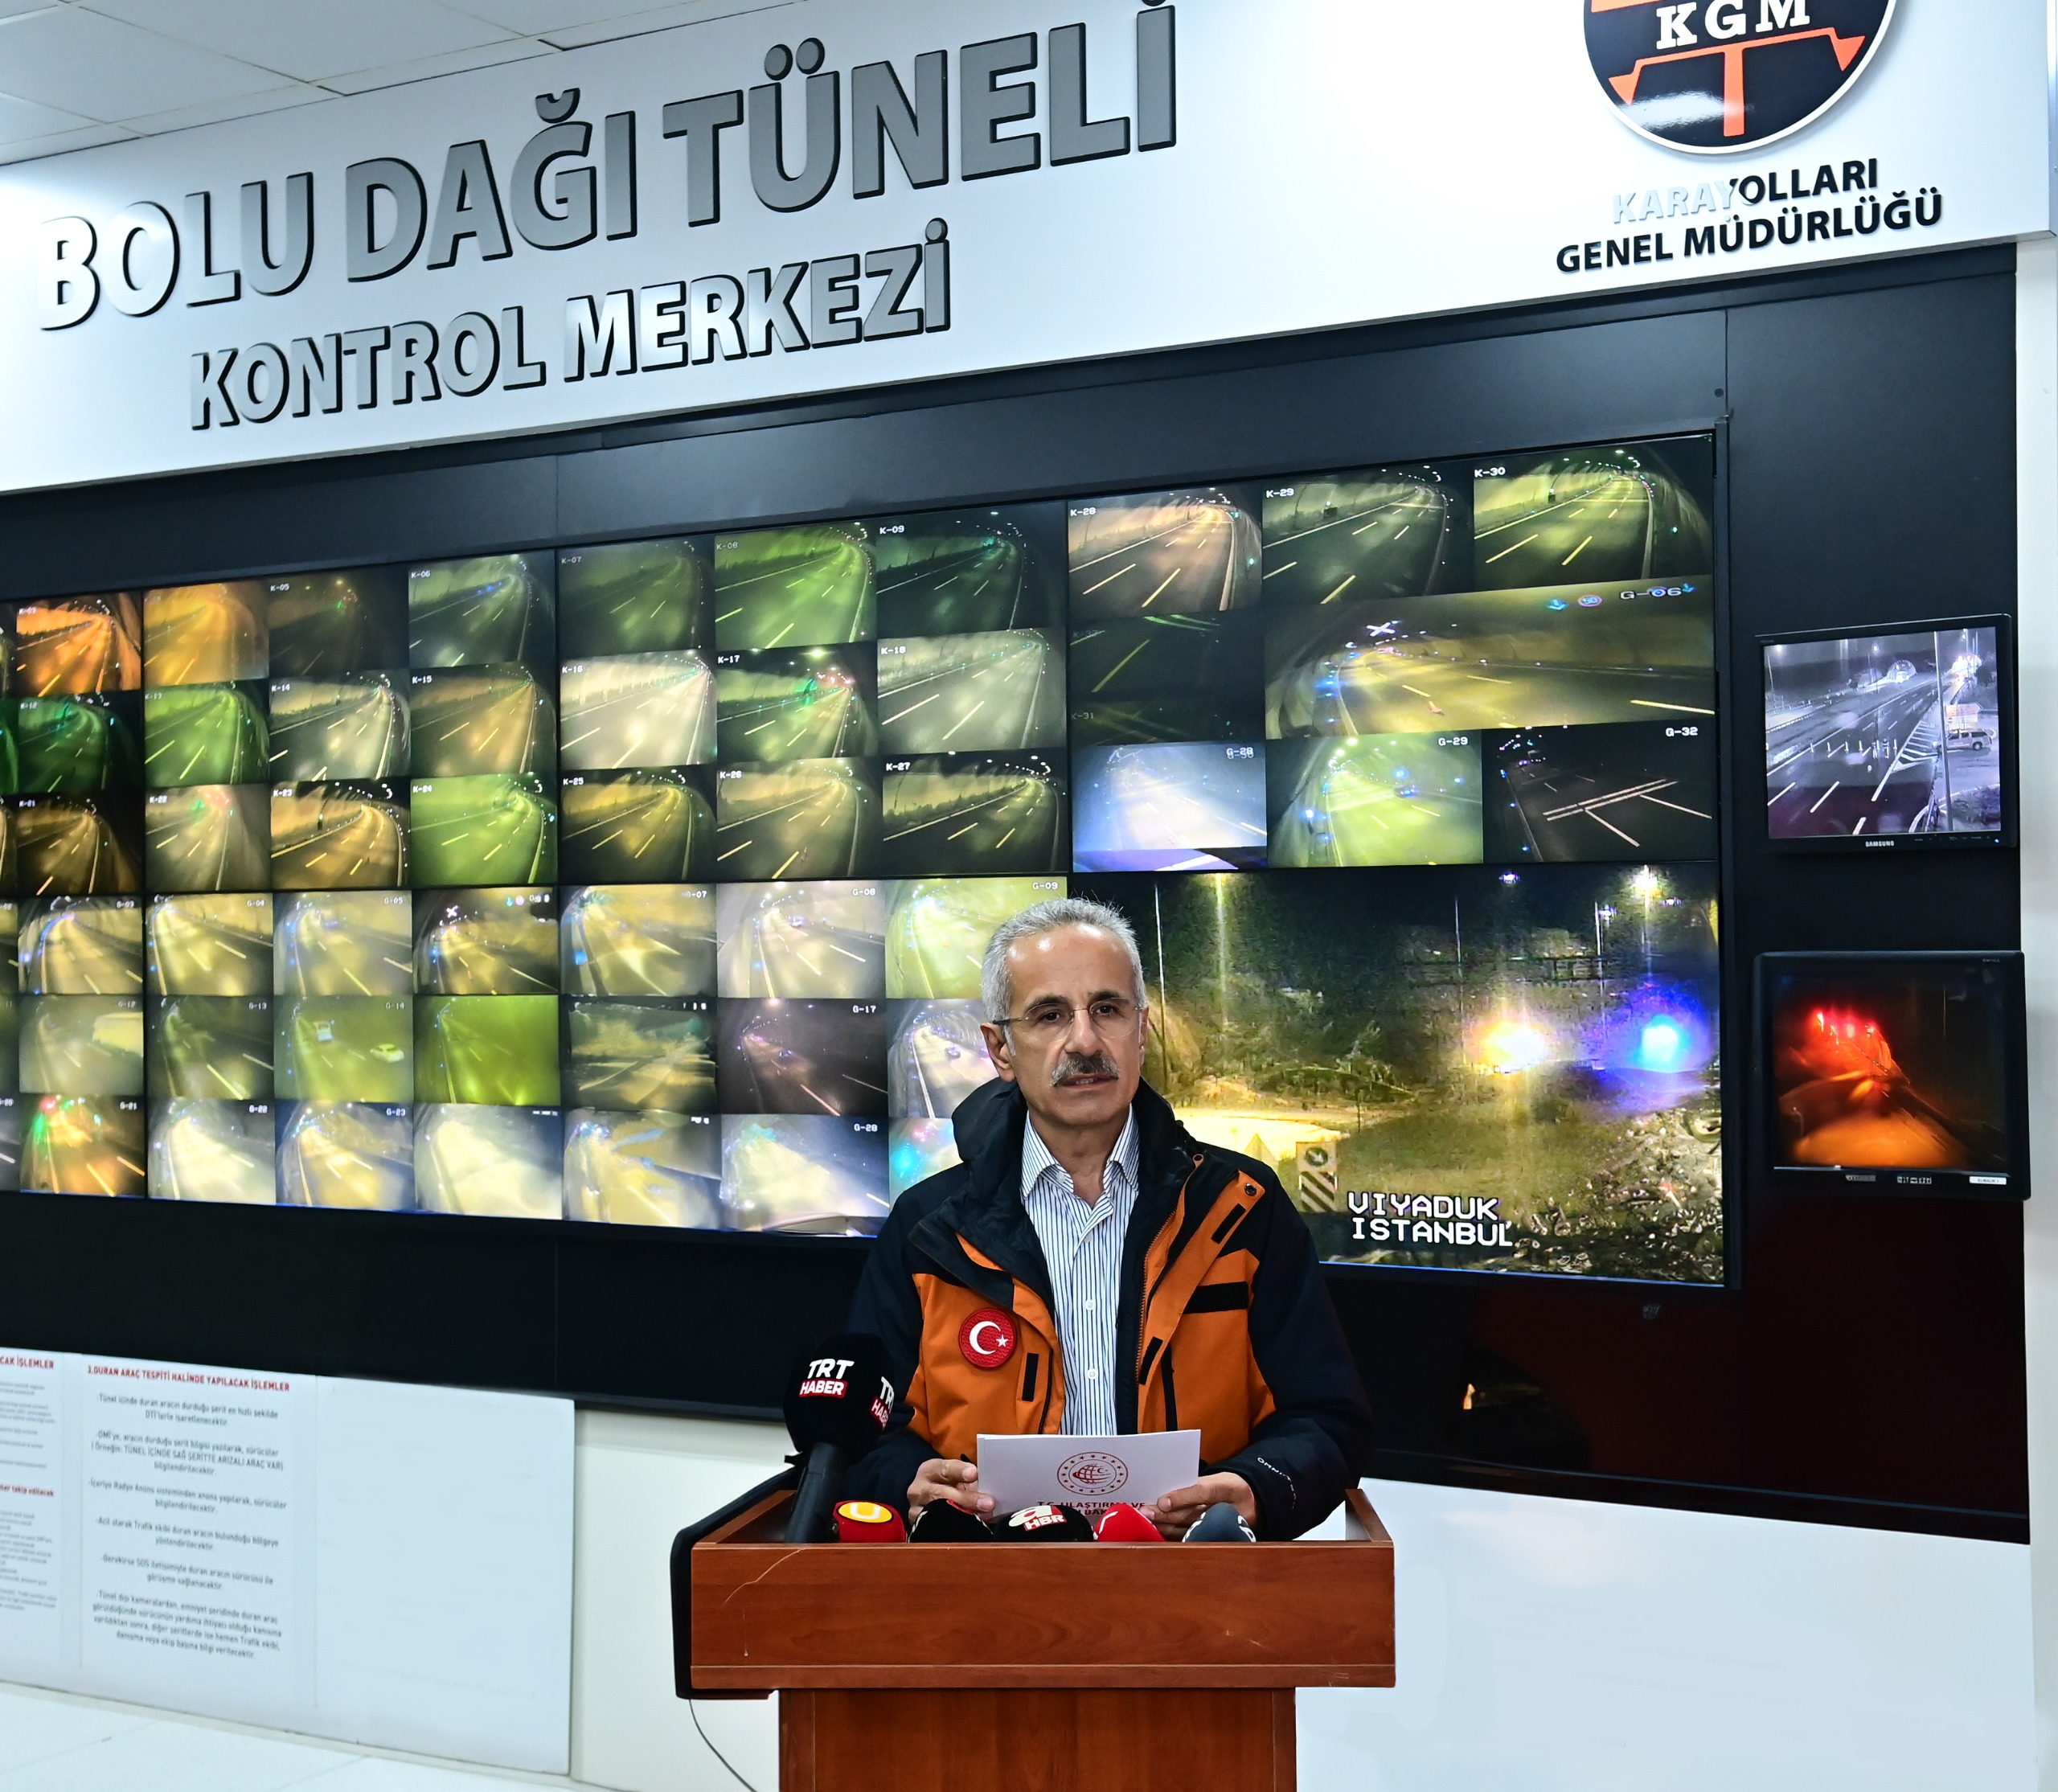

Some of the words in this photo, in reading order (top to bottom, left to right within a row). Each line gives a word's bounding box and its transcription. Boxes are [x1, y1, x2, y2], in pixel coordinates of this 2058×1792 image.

[1656, 0, 1810, 50] KGM
[38, 172, 314, 330] BOLU
[345, 88, 637, 283] DAĞI
[662, 0, 1176, 228] TÜNELİ
[1613, 158, 1879, 223] KARAYOLLARI
[1556, 232, 1674, 273] GENEL
[1683, 187, 1943, 257] MÜDÜRLÜĞÜ
[191, 306, 547, 431] KONTROL
[564, 217, 951, 382] MERKEZİ
[1474, 466, 1506, 478] K-30
[1265, 488, 1294, 498] K-29
[1070, 507, 1097, 517] K-28
[879, 525, 905, 535] K-09
[716, 542, 739, 551] K-08
[561, 556, 582, 564] K-07
[411, 570, 431, 578] K-06
[1620, 587, 1682, 600] G-06
[718, 654, 740, 664] K-17
[412, 675, 433, 683] K-15
[271, 683, 291, 692] K-14
[1665, 727, 1699, 737] G-32
[1437, 736, 1469, 747] G-29
[885, 762, 912, 772] K-27
[563, 777, 584, 785] K-25
[1032, 882, 1059, 891] G-09
[852, 888, 876, 896] G-08
[852, 1005, 877, 1014] G-17
[1348, 1191, 1498, 1221] VIYADUK
[1352, 1216, 1514, 1247] ISTANBUL
[17, 1354, 54, 1370] İŞLEMLER
[807, 1358, 855, 1380] TRT
[121, 1368, 140, 1379] ARAÇ
[142, 1369, 170, 1380] TESPİTİ
[172, 1372, 204, 1384] HALİNDE
[207, 1376, 248, 1388] YAPILACAK
[251, 1377, 290, 1392] İŞLEMLER
[800, 1380, 845, 1396] HABER
[1024, 1515, 1065, 1530] HBR
